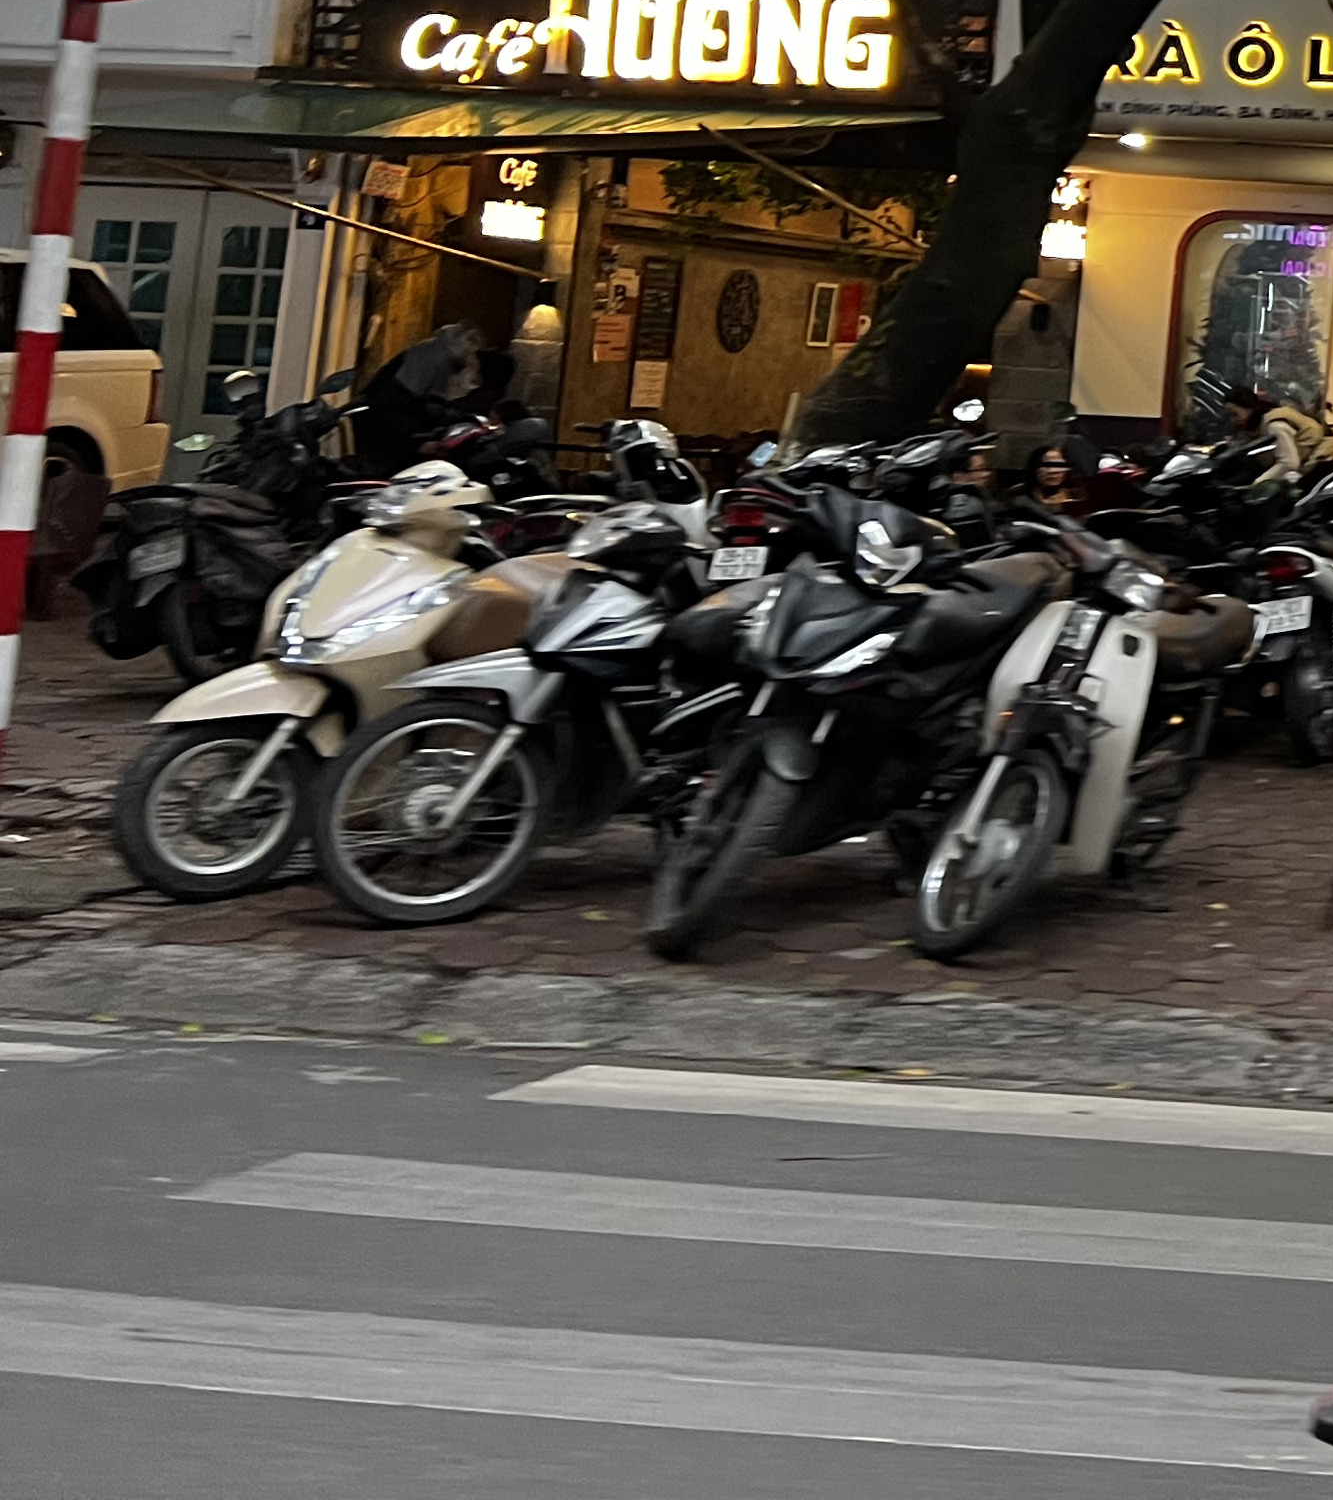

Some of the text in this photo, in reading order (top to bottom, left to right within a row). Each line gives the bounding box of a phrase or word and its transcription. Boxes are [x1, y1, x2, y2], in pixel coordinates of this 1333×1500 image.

[400, 12, 536, 85] Café
[1103, 18, 1199, 84] RÀ
[1224, 19, 1285, 87] Ô
